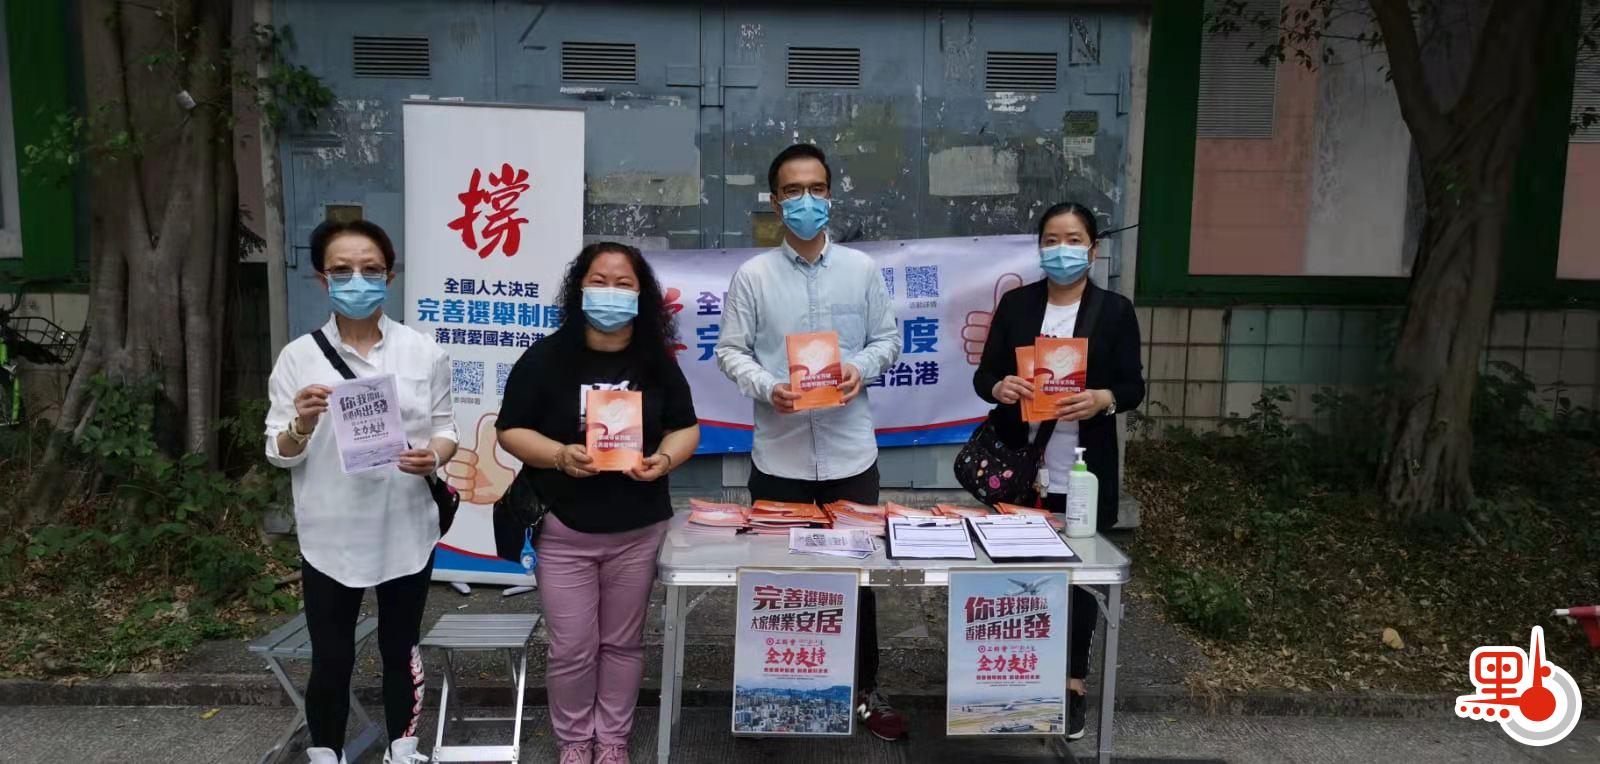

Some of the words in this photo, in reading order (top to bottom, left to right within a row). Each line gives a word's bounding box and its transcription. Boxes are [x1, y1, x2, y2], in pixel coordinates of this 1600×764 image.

[447, 163, 532, 259] 撐
[444, 278, 540, 298] 全國人大決定
[417, 298, 564, 328] 完善選舉制度
[696, 291, 729, 315] 全
[894, 316, 939, 354] 度
[752, 585, 844, 611] 完善選舉制度
[750, 608, 844, 634] 大家樂業安居
[965, 612, 1051, 641] 香港再出發
[765, 647, 826, 668] 全力支持
[977, 653, 1038, 674] 全力支持
